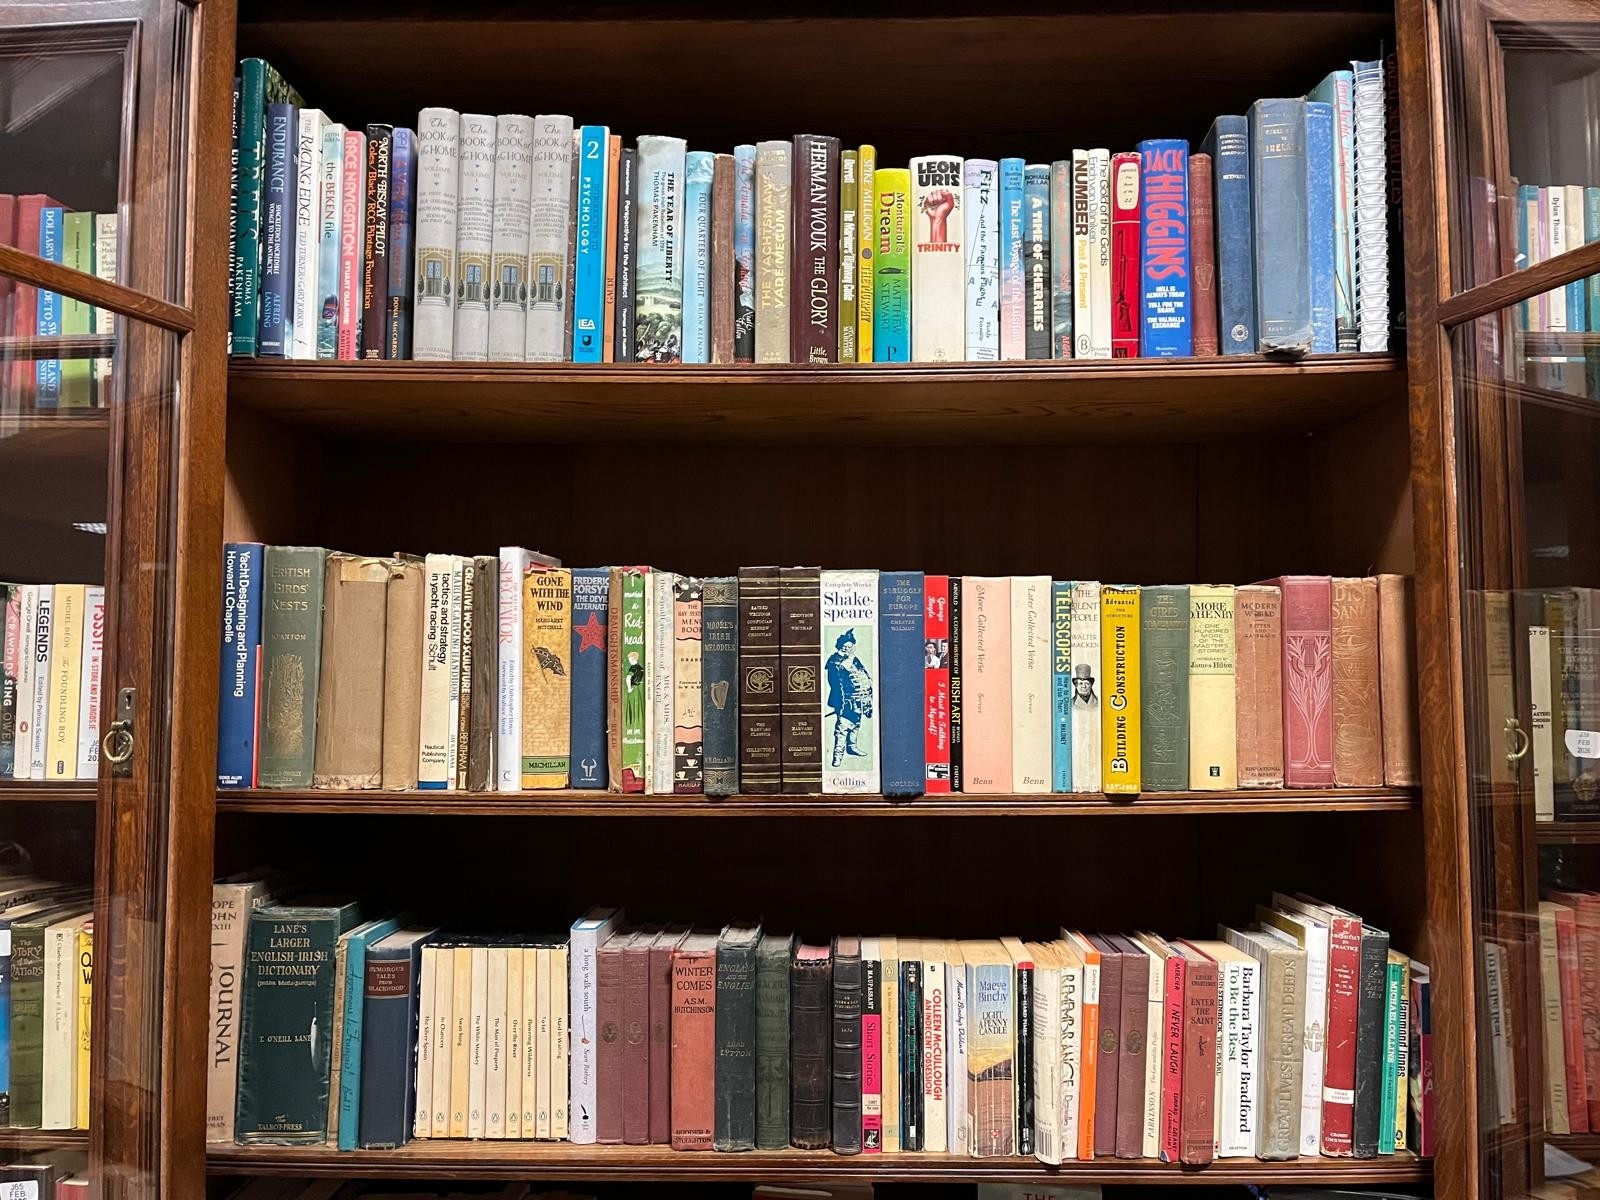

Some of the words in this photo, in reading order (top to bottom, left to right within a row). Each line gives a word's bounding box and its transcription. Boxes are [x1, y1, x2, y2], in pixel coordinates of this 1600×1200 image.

[544, 124, 561, 134] The
[270, 116, 287, 193] ENDURANCE
[586, 141, 599, 159] 2
[325, 162, 336, 180] the
[917, 161, 960, 174] LEON
[1143, 149, 1184, 173] JACK
[918, 174, 960, 187] URIS
[325, 182, 335, 219] BEKEN
[666, 194, 674, 221] YEAR
[1032, 197, 1042, 209] A
[580, 177, 591, 254] PSYCHOLOGY
[880, 192, 895, 254] Dream
[324, 222, 335, 239] file
[666, 223, 673, 237] OF
[1032, 211, 1042, 243] TIME
[1146, 174, 1186, 280] HIGGINS
[917, 243, 960, 253] TRINITY
[1032, 244, 1043, 261] OF
[665, 240, 673, 283] LIBERTY
[234, 256, 244, 318] PAKENHAM
[245, 269, 253, 305] THOMAS
[1033, 263, 1044, 332] CHERRIES
[264, 291, 273, 328] LANSING
[272, 293, 281, 324] ALFRED
[880, 283, 890, 331] STEWART
[893, 279, 902, 334] MATTHEW
[240, 550, 251, 579] Yacht
[271, 567, 311, 578] BRITISH
[441, 573, 452, 605] tactics
[463, 567, 474, 611] CREATIVE
[537, 576, 564, 587] GONE
[824, 581, 854, 589] Complete
[500, 561, 513, 644] SPECTATOR
[530, 588, 554, 598] WITH
[556, 588, 570, 598] THE
[823, 591, 874, 606] Shake-
[976, 585, 986, 611] More
[1078, 589, 1093, 598] THE
[236, 579, 249, 631] Designing
[271, 600, 309, 611] NESTS
[440, 607, 449, 623] and
[537, 601, 563, 611] WIND
[823, 608, 873, 622] speare
[1194, 602, 1227, 611] MORE
[1241, 602, 1278, 610] MODERN
[462, 613, 472, 644] WOOD
[706, 621, 734, 629] MOORE'S
[1071, 614, 1098, 622] PEOPLE
[36, 600, 50, 662] LEGENDS
[237, 632, 247, 651] and
[624, 632, 644, 645] head
[977, 614, 986, 650] Collected
[1055, 589, 1071, 673] TELESCOPES
[4, 616, 17, 677] CRAWDADS
[437, 624, 450, 665] strategy
[704, 644, 736, 652] MELODIES
[461, 645, 472, 694] SCULPTURE
[977, 651, 986, 674] Verse
[1190, 661, 1213, 669] James
[1214, 661, 1233, 669] Hilton
[233, 652, 248, 697] Planning
[3, 679, 13, 706] SING
[459, 732, 469, 770] BENTHAM
[832, 777, 866, 787] Collins
[972, 777, 993, 785] Benn
[1023, 776, 1045, 785] Benn
[273, 924, 307, 934] LANE'S
[12, 944, 43, 960] STORY
[270, 938, 310, 948] LARGER
[251, 951, 329, 962] ENGLISH-IRISH
[258, 965, 319, 976] DICTIONARY
[674, 967, 713, 977] WINTER
[1229, 968, 1240, 987] To
[676, 980, 712, 991] COMES
[979, 980, 1007, 991] Maeve
[1241, 967, 1254, 1021] Barbara
[925, 999, 931, 1010] AN
[978, 991, 1008, 1004] Binchy
[1190, 999, 1215, 1007] ENTER
[1229, 987, 1240, 1006] Be
[1389, 981, 1398, 1024] MICHAEL
[214, 964, 235, 1069] JOURNAL
[674, 1006, 714, 1014] HUTCHINSON
[932, 988, 942, 1031] COLLEEN
[982, 1011, 1003, 1019] LIGHT
[1228, 1007, 1240, 1032] the
[978, 1026, 1008, 1036] CANDLE
[1190, 1017, 1214, 1025] SAINT
[1398, 999, 1409, 1050] Hammond
[866, 1022, 875, 1048] Short
[1239, 1022, 1253, 1069] Taylor
[1387, 1024, 1397, 1063] COLLINS
[1228, 1032, 1240, 1062] Best
[526, 1046, 534, 1077] Wilderness
[865, 1053, 875, 1087] Stories
[933, 1033, 942, 1101] McCULLOUGH
[1397, 1051, 1408, 1077] Innes
[1240, 1071, 1252, 1133] Bradford
